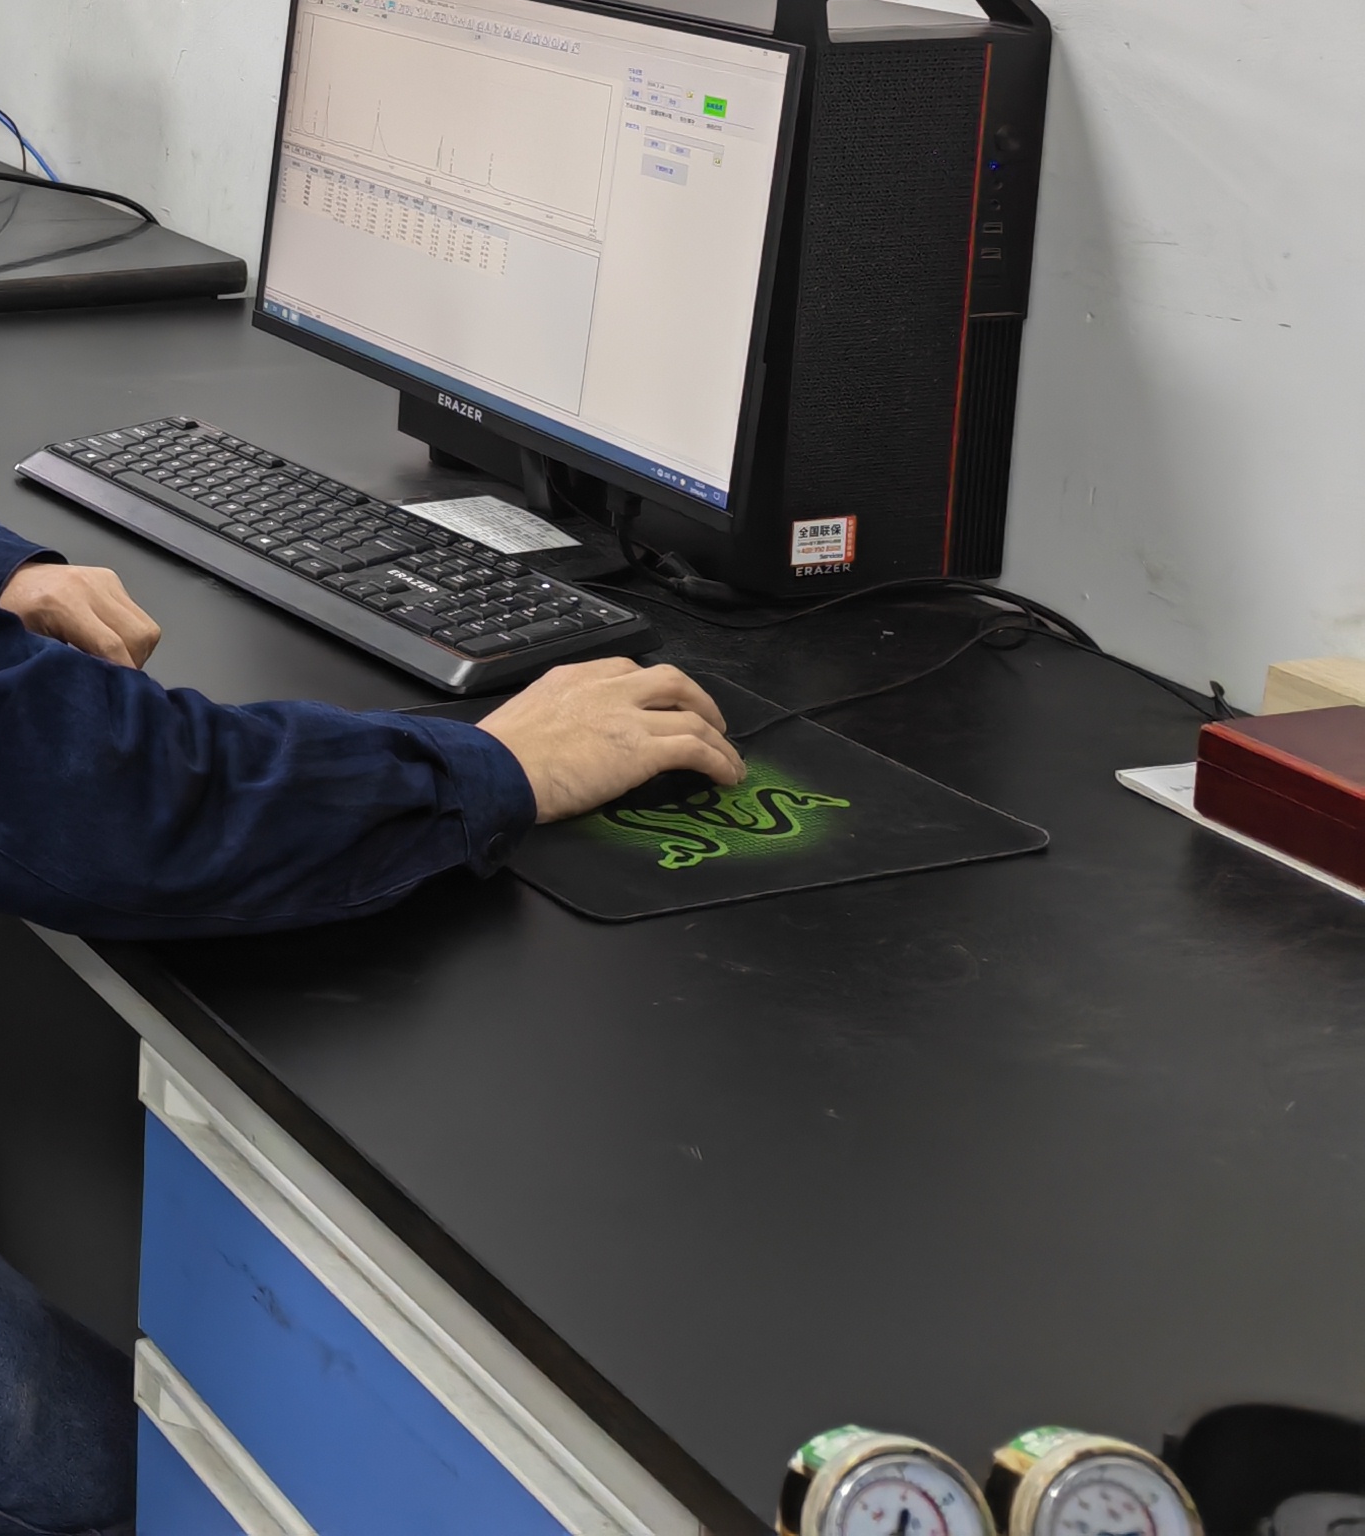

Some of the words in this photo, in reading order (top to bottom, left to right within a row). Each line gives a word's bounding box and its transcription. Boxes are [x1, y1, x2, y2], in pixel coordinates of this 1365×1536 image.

[437, 392, 483, 423] ERAZER
[798, 524, 841, 538] 全国联保
[795, 563, 851, 577] ERAZER
[386, 568, 439, 594] ERAZER
